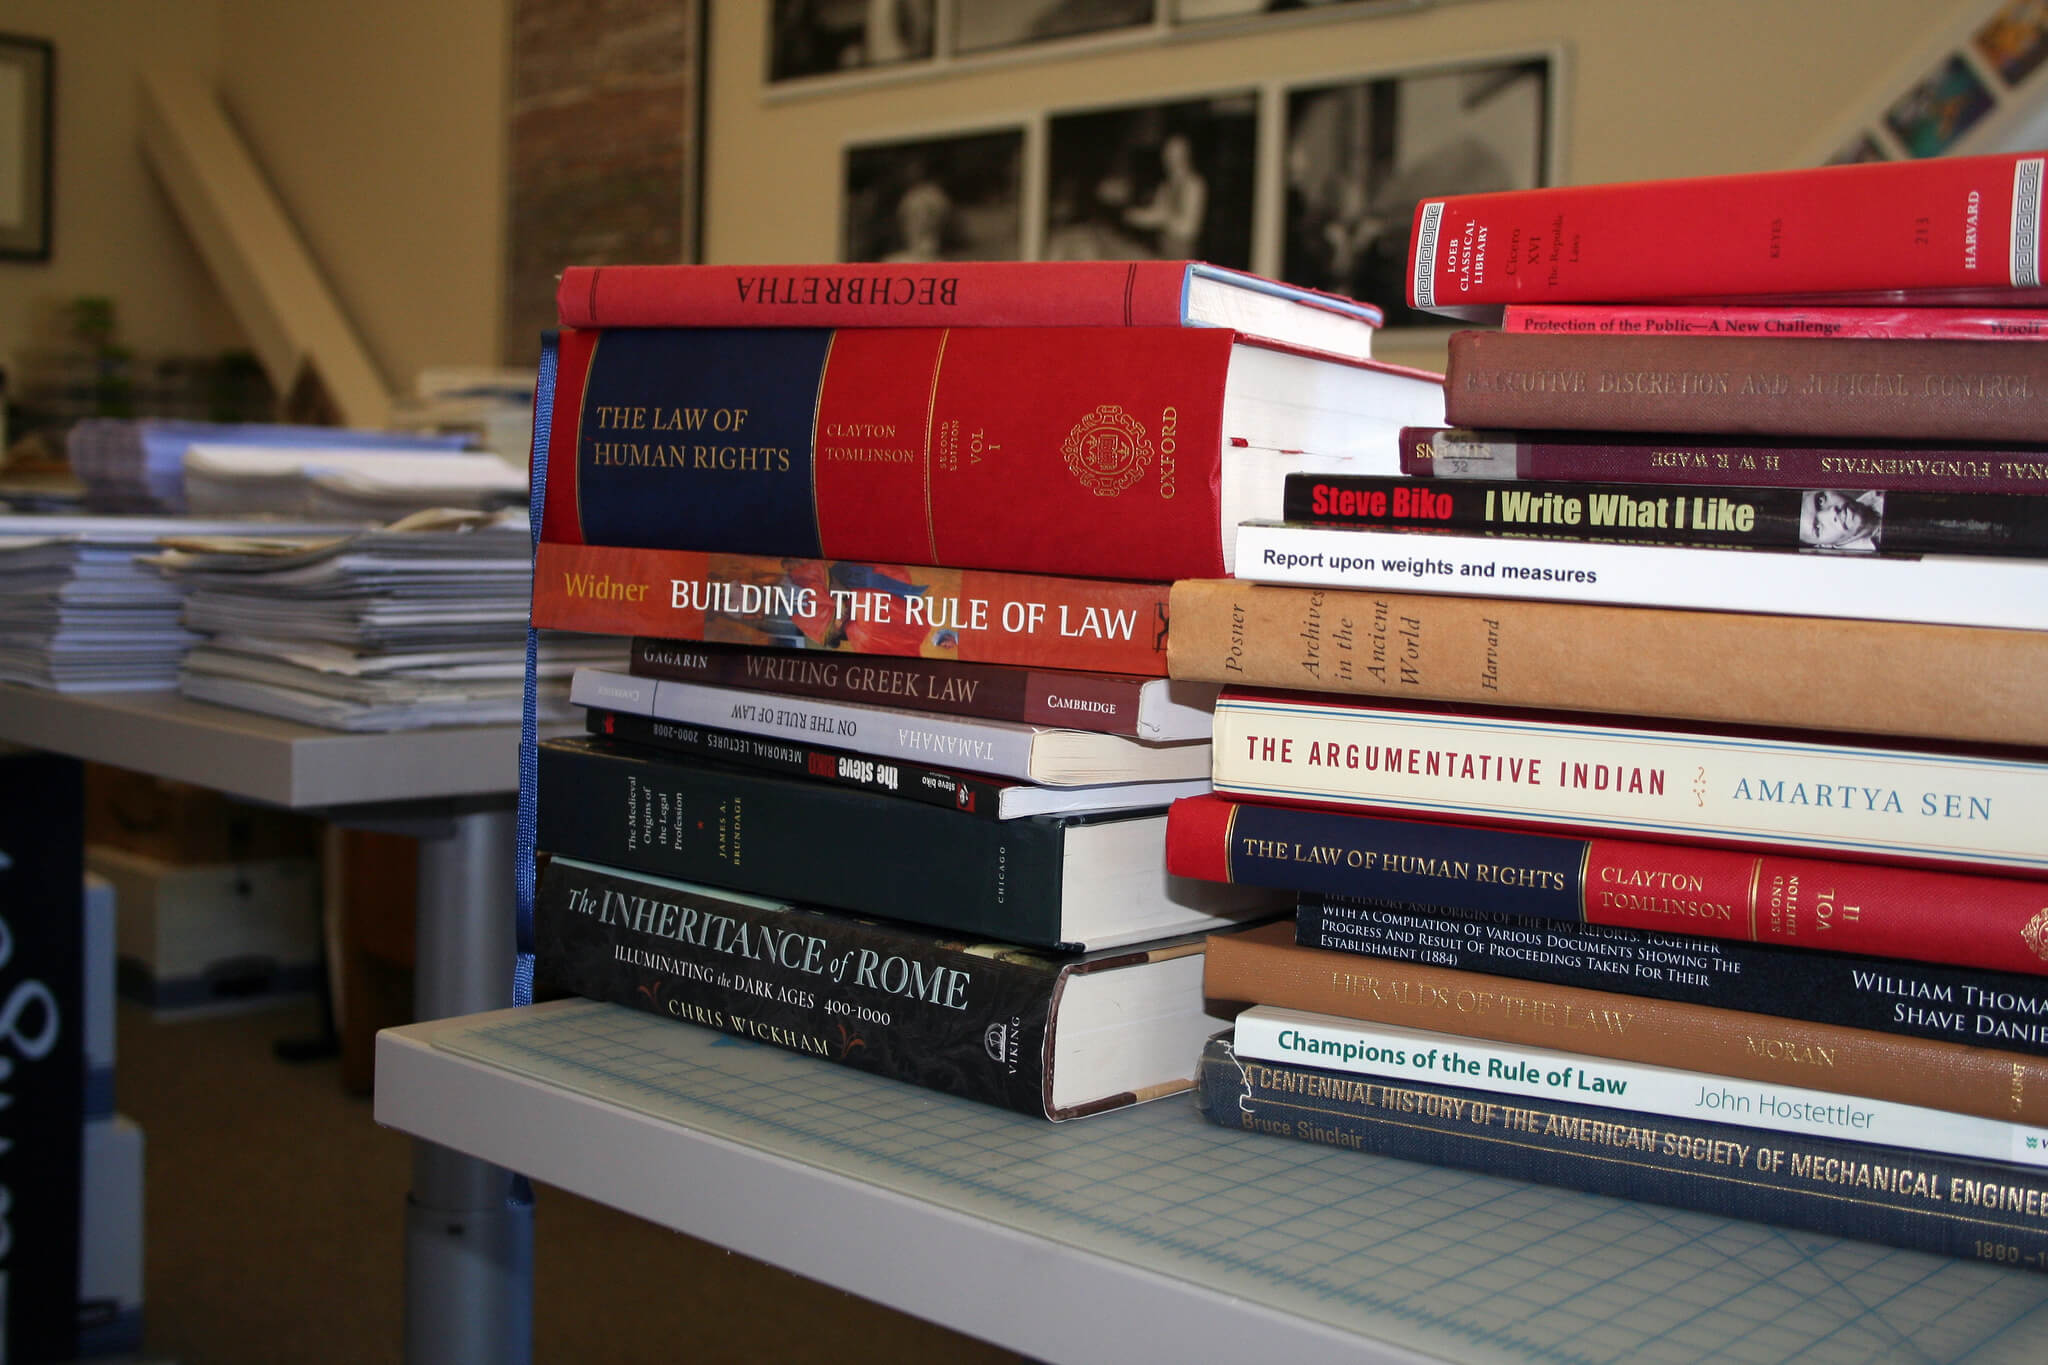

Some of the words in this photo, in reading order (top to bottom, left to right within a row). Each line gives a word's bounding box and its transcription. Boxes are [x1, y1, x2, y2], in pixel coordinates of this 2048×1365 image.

[1965, 191, 1980, 269] HARVARD
[1447, 238, 1459, 273] LOEB
[1460, 219, 1475, 292] CLASSICAL
[1474, 226, 1488, 284] LIBRARY
[1506, 228, 1520, 276] Cicero
[1528, 237, 1541, 265] XVI
[736, 276, 959, 305] BECHBRETHA
[1524, 318, 1597, 332] Protection
[1600, 318, 1616, 331] of
[1620, 318, 1640, 332] the
[1725, 320, 1759, 333] New
[1765, 319, 1842, 335] Challenge
[1600, 372, 1729, 393] DISCRETION
[597, 406, 646, 430] THE
[654, 407, 707, 432] LAW
[713, 408, 748, 432] OF
[826, 424, 896, 438] CLAYTON
[593, 443, 686, 468] HUMAN
[694, 446, 790, 472] RIGHTS
[825, 447, 914, 464] TOMLINSON
[939, 421, 949, 469] SECOND
[950, 419, 960, 472] EDITION
[970, 428, 984, 464] VOL
[1160, 405, 1178, 500] OXFORD
[1651, 452, 1708, 468] WADE
[1821, 455, 1991, 478] FUNDAMENTALS
[1312, 484, 1386, 517] Steve
[1393, 487, 1453, 520] Biko
[1486, 491, 1494, 521] I
[1501, 491, 1581, 525] Write
[1589, 494, 1667, 528] What
[1675, 497, 1685, 529] I
[1692, 497, 1755, 532] Like
[1263, 549, 1324, 569] Report
[1329, 555, 1375, 573] upon
[1382, 556, 1454, 577] weights
[1460, 561, 1495, 577] and
[1502, 566, 1597, 584] measures
[564, 572, 649, 602] Widner
[670, 579, 817, 618] BUILDING
[830, 589, 891, 623] THE
[903, 594, 989, 630] RULE
[1002, 601, 1046, 634] OF
[1059, 604, 1137, 641] LAW
[1226, 604, 1245, 673] Posner
[1301, 590, 1326, 679] Archives
[1332, 618, 1354, 652] the
[1366, 599, 1391, 683] Ancient
[1398, 616, 1420, 686] World
[1335, 662, 1352, 681] in
[1482, 619, 1500, 691] Harvard
[745, 655, 838, 688] WRITING
[845, 666, 920, 697] GREEK
[928, 675, 979, 704] LAW
[731, 704, 756, 722] LAW
[758, 707, 773, 724] OF
[777, 709, 807, 730] RULE
[810, 713, 834, 734] THE
[837, 716, 857, 737] ON
[707, 733, 750, 756] LECTURES
[754, 742, 802, 764] MEMORIAL
[898, 728, 994, 761] TAMANAHA
[838, 755, 873, 784] steve
[877, 763, 899, 790] the
[1247, 735, 1293, 763] THE
[1308, 741, 1541, 785] ARGUMENTATIVE
[1560, 761, 1665, 796] INDIAN
[628, 776, 637, 826] Medieval
[643, 786, 651, 801] of
[659, 793, 669, 823] Legal
[1733, 777, 1903, 814] AMARTYA
[1921, 793, 1992, 821] SEN
[629, 827, 637, 851] The
[644, 803, 653, 844] Origins
[659, 826, 667, 845] the
[674, 792, 683, 850] Profession
[998, 846, 1006, 904] CHICAGO
[1243, 838, 1288, 860] THE
[1294, 844, 1341, 866] LAW
[1347, 850, 1377, 870] OF
[1382, 854, 1468, 881] HUMAN
[1477, 861, 1565, 891] RIGHTS
[1601, 866, 1704, 892] CLAYTON
[1601, 891, 1732, 921] TOMLINSON
[1771, 875, 1783, 932] SECOND
[1787, 874, 1800, 936] EDITION
[1816, 888, 1834, 931] VOL
[1843, 905, 1860, 921] II
[569, 888, 597, 916] The
[598, 889, 827, 976] INHERITANCE
[830, 950, 854, 984] of
[854, 948, 971, 1011] ROME
[1321, 934, 1417, 961] ESTABLISHMENT
[1420, 950, 1458, 967] (1884)
[1322, 905, 1357, 920] WITH
[1360, 909, 1369, 921] A
[1373, 911, 1459, 933] COMPILATION
[1486, 926, 1541, 945] VARIOUS
[1547, 935, 1632, 959] DOCUMENTS
[1638, 947, 1707, 969] SHOWING
[1712, 958, 1741, 973] THE
[1322, 919, 1382, 938] PROGRESS
[1386, 928, 1414, 943] AND
[1419, 932, 1463, 950] RESULT
[1489, 944, 1581, 968] PROCEEDINGS
[1586, 956, 1629, 974] TAKEN
[1635, 963, 1663, 980] FOR
[1666, 968, 1710, 986] THEIR
[614, 944, 714, 984] ILLUMINATING
[717, 972, 731, 988] the
[734, 974, 773, 1000] DARK
[777, 984, 815, 1009] AGES
[824, 999, 891, 1026] 400-1000
[1332, 971, 1449, 1005] HERALDS
[1456, 989, 1494, 1014] OF
[1500, 996, 1557, 1026] THE
[1563, 1006, 1635, 1035] LAW
[1852, 969, 1952, 1002] WILLIAM
[668, 999, 723, 1028] CHRIS
[731, 1015, 829, 1056] WICKHAM
[1894, 1003, 1965, 1031] SHAVE
[1008, 1016, 1021, 1074] VIKING
[1278, 1029, 1406, 1067] Champions
[1412, 1047, 1438, 1069] of
[1440, 1053, 1480, 1075] the
[1488, 1059, 1541, 1084] Rule
[1547, 1067, 1572, 1088] of
[1579, 1070, 1627, 1096] Law
[1746, 1035, 1836, 1068] MORAN
[1695, 1086, 1750, 1114] John
[1759, 1093, 1875, 1130] Hostettler
[1240, 1064, 1256, 1086] A
[1259, 1067, 1375, 1108] CENTENNIAL
[1381, 1087, 1464, 1121] HISTORY
[1471, 1101, 1497, 1126] OF
[1503, 1106, 1539, 1134] THE
[1544, 1112, 1657, 1152] AMERICAN
[1663, 1132, 1750, 1169] SOCIETY
[1756, 1148, 1784, 1173] OF
[1790, 1152, 1942, 1200] MECHANICAL
[1242, 1112, 1291, 1136] Bruce
[1298, 1119, 1364, 1149] Sinclair
